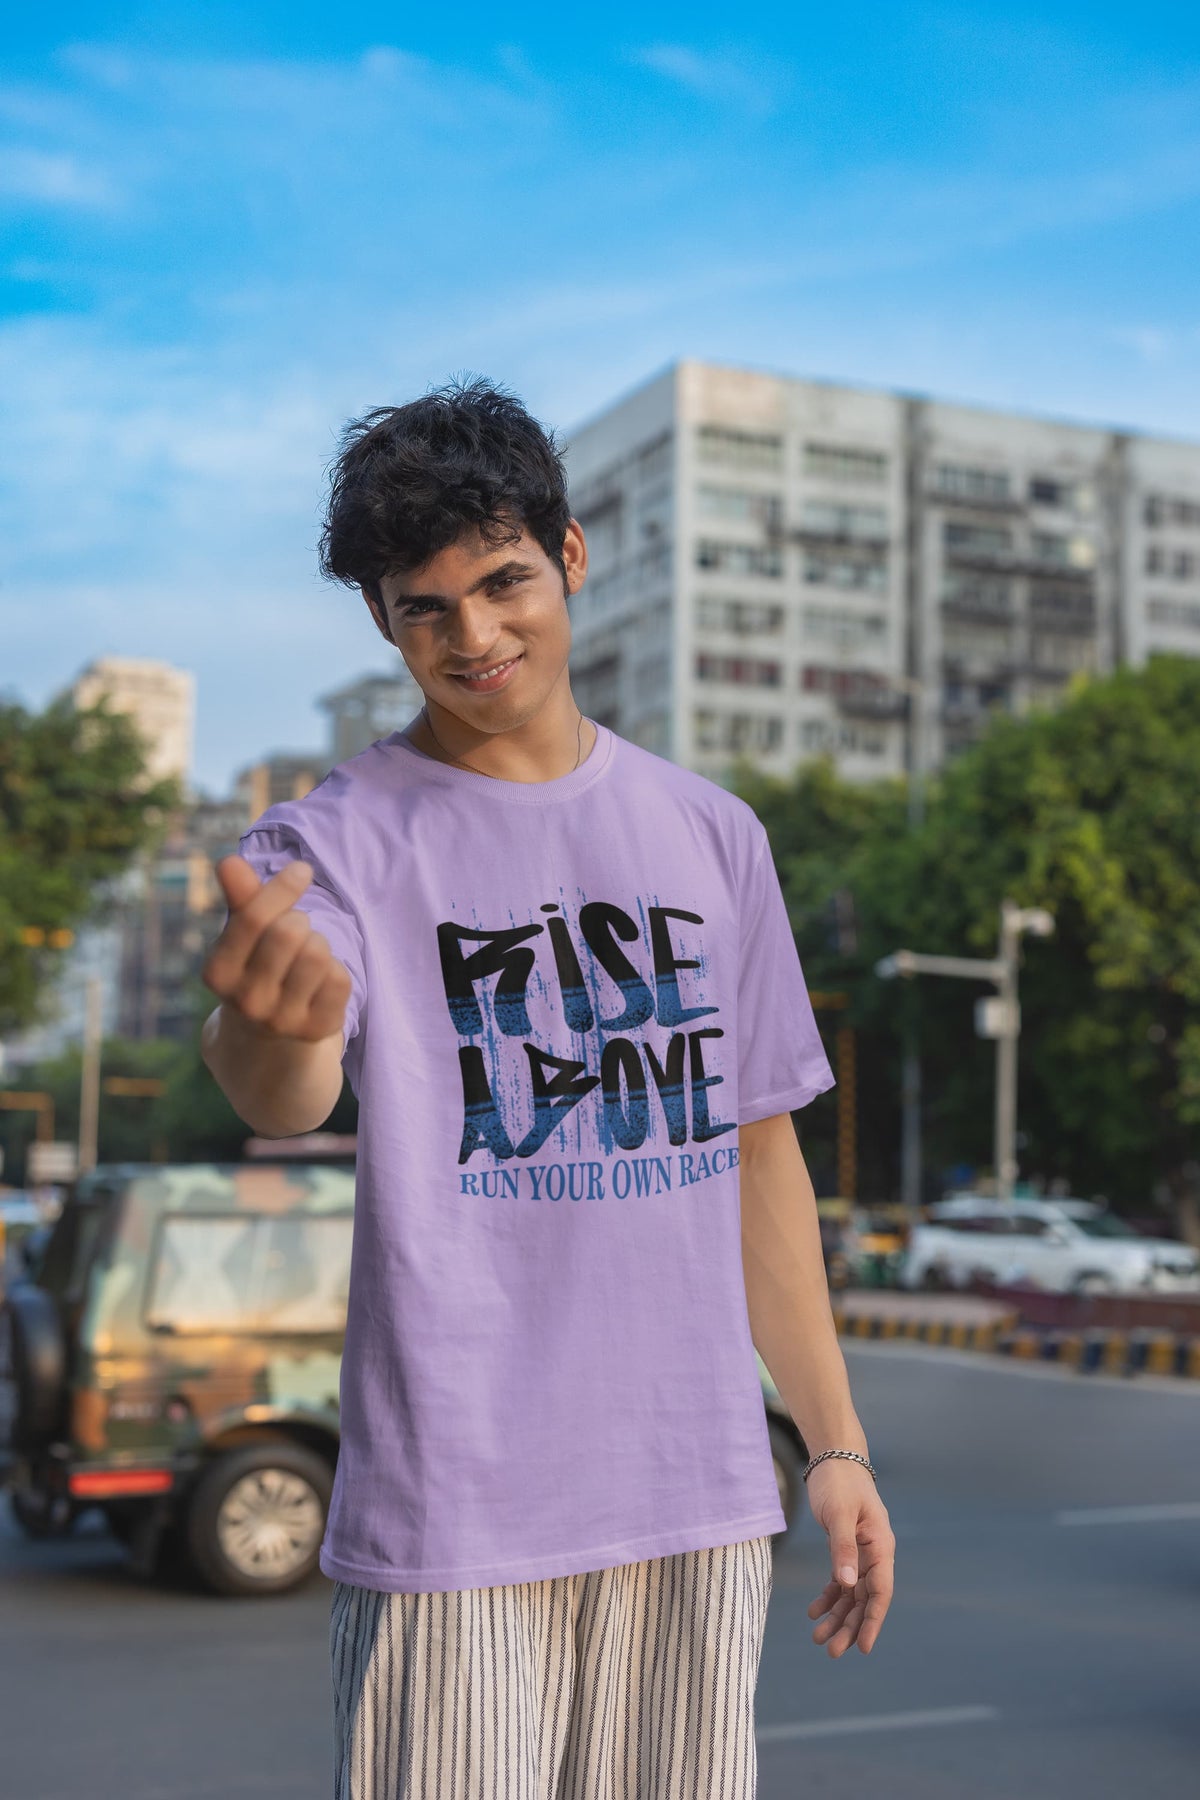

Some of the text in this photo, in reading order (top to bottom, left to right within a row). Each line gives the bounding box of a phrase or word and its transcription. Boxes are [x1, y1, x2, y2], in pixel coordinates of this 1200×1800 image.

[458, 1028, 737, 1165] ABOVE
[459, 1147, 740, 1201] RUN YOUR OWN RACE
